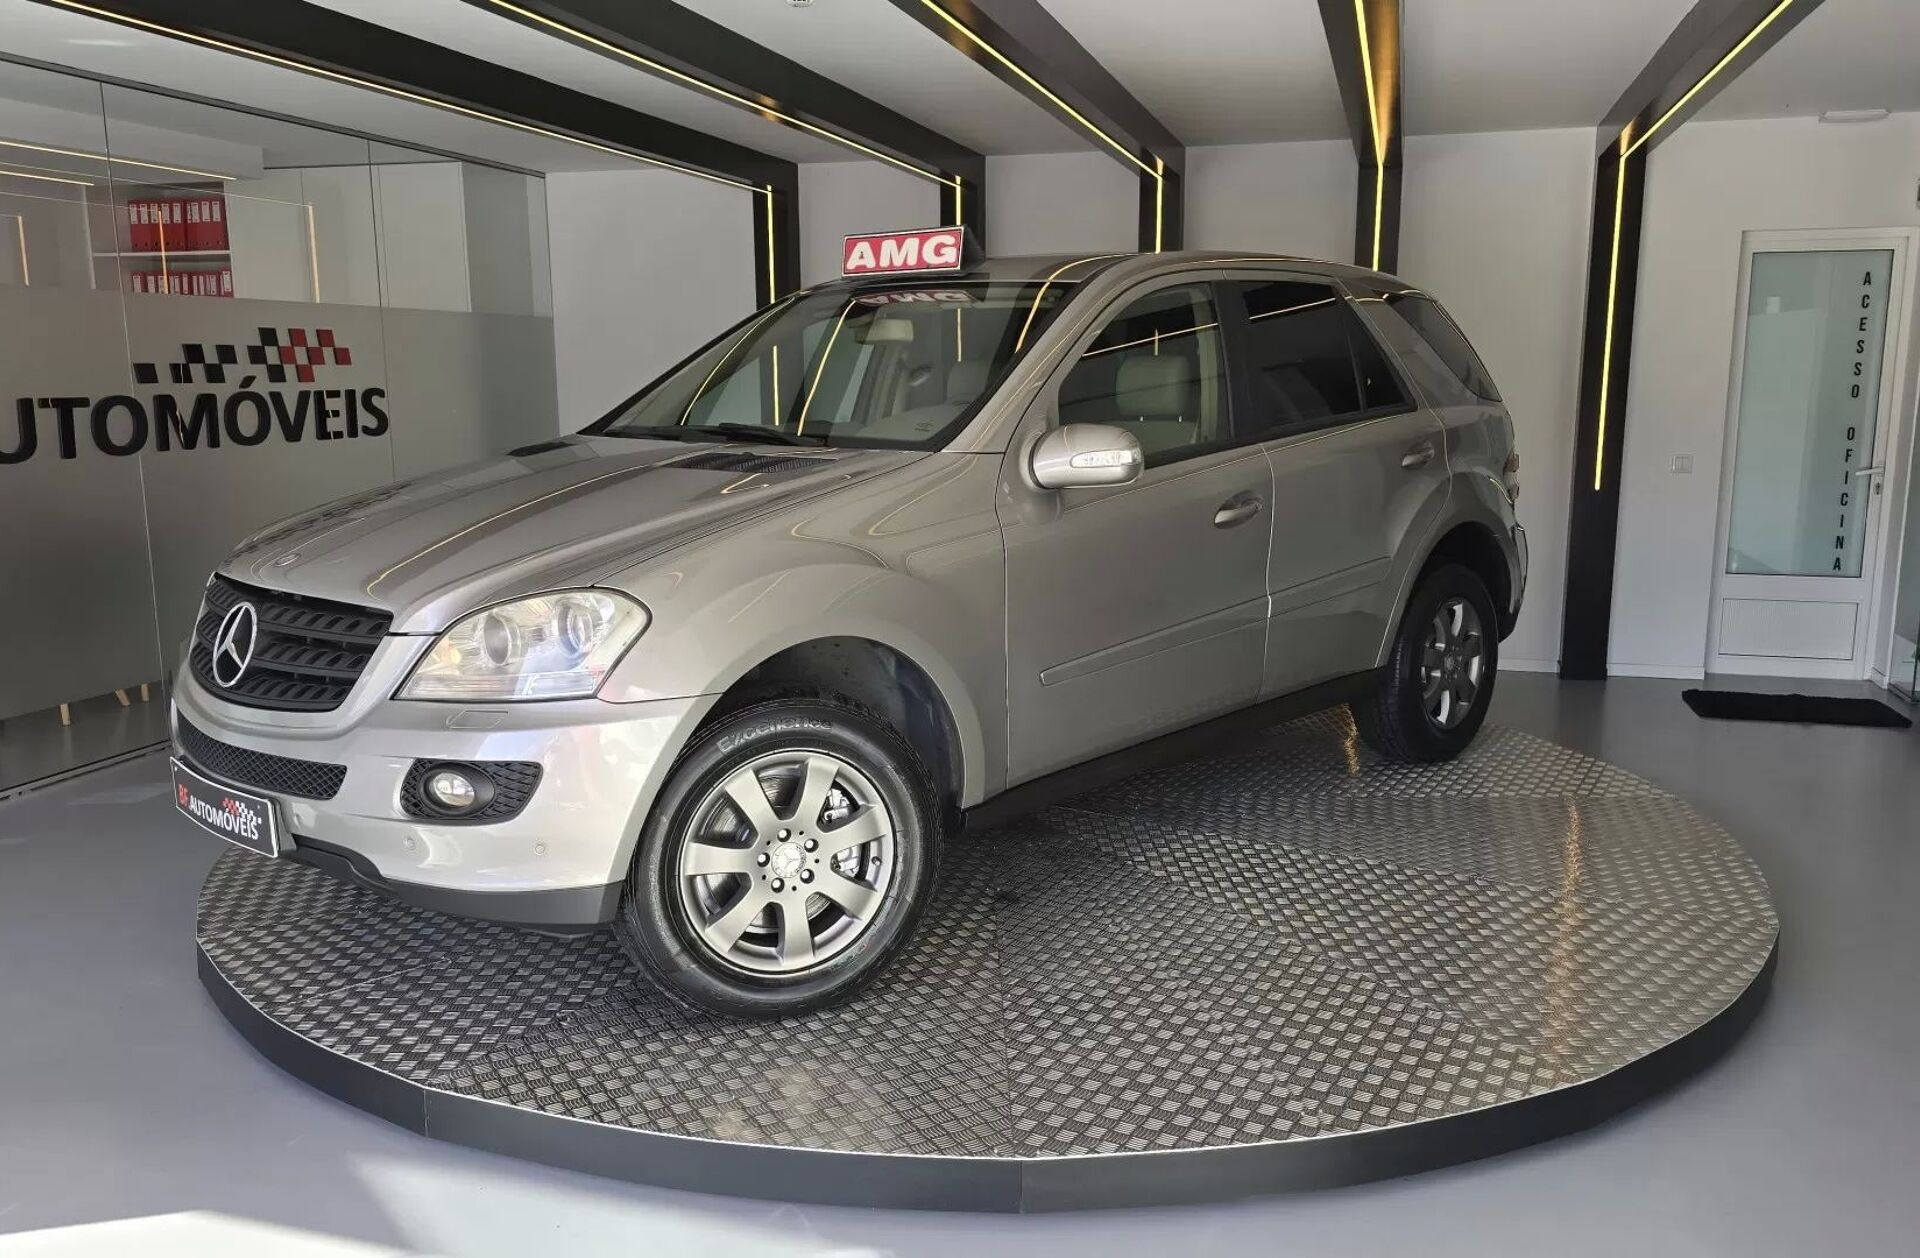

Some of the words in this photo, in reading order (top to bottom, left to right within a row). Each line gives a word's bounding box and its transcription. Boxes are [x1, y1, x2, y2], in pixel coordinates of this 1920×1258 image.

[846, 234, 957, 270] AMG
[1850, 271, 1872, 399] ACESSO
[1832, 427, 1856, 571] OFICINA
[188, 795, 259, 840] AUTOMÓVEIS
